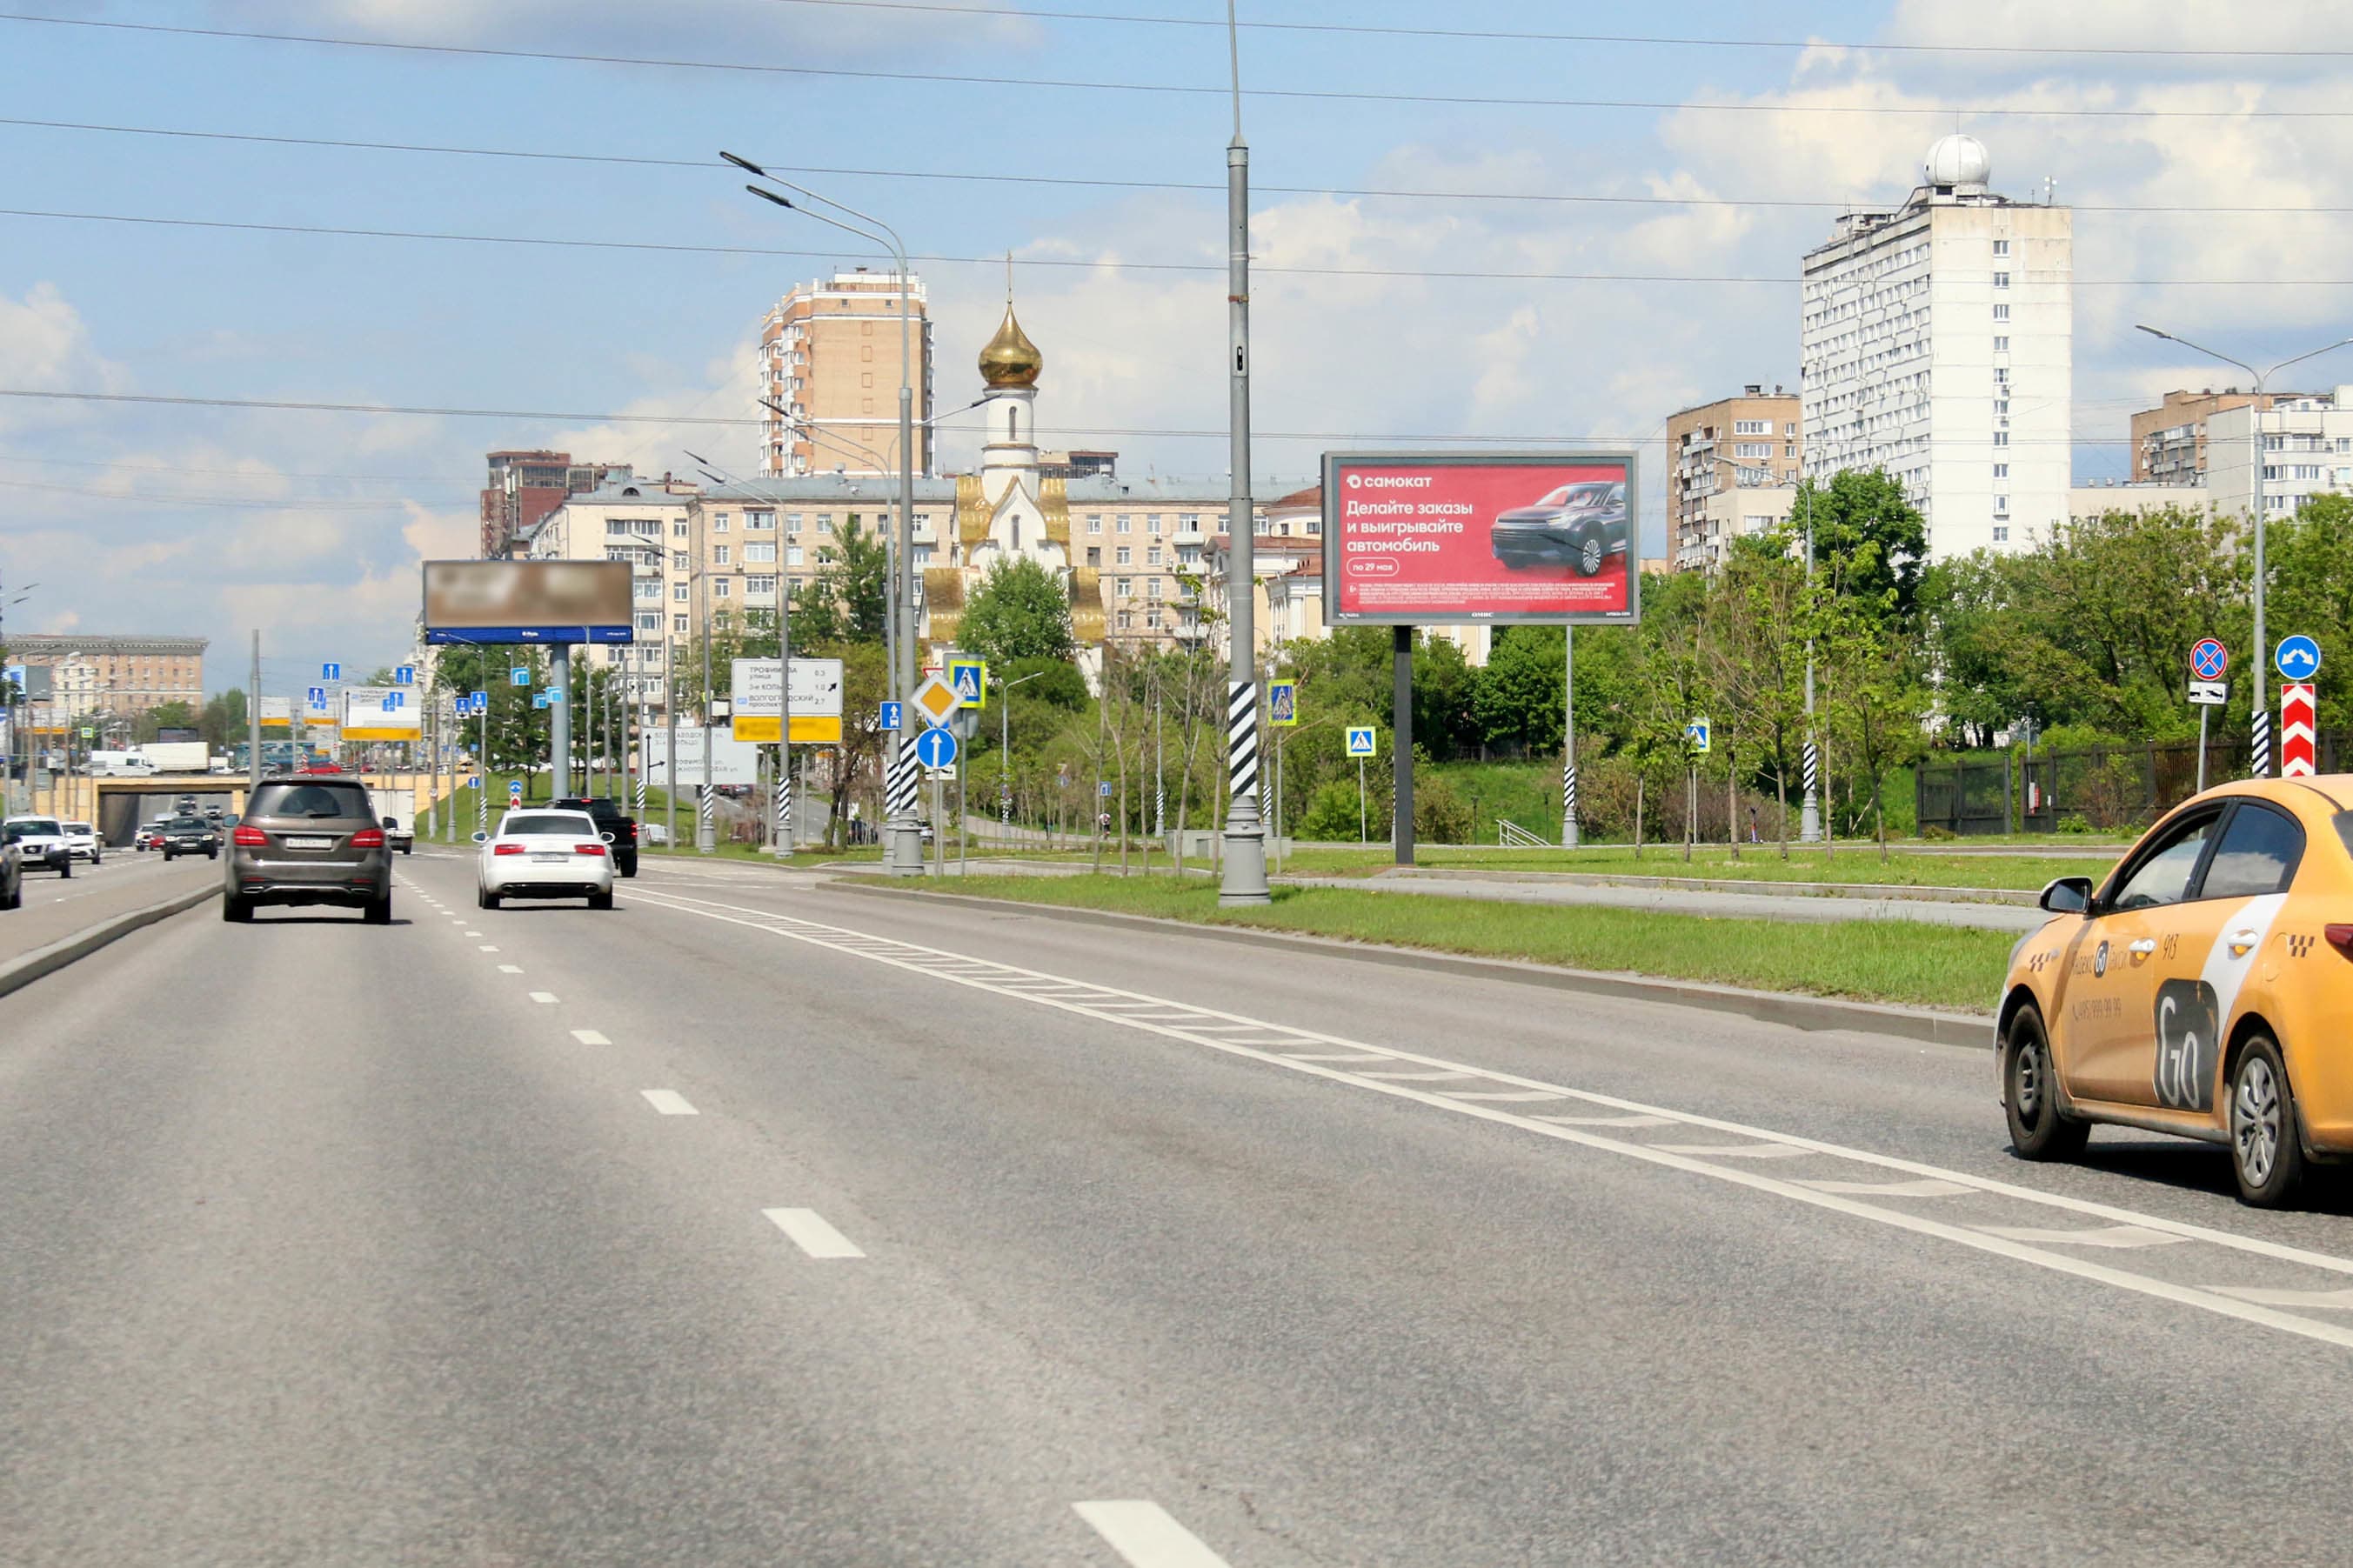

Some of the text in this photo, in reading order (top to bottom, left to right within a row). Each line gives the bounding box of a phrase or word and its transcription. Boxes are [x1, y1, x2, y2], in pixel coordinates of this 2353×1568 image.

[1364, 477, 1432, 488] самокат
[1347, 499, 1473, 517] Делайте заказы
[1347, 518, 1463, 537] и выигрывайте
[1347, 537, 1440, 552] автомобиль
[1365, 563, 1375, 571] 29
[2163, 933, 2179, 960] 913
[2160, 996, 2200, 1109] Go
